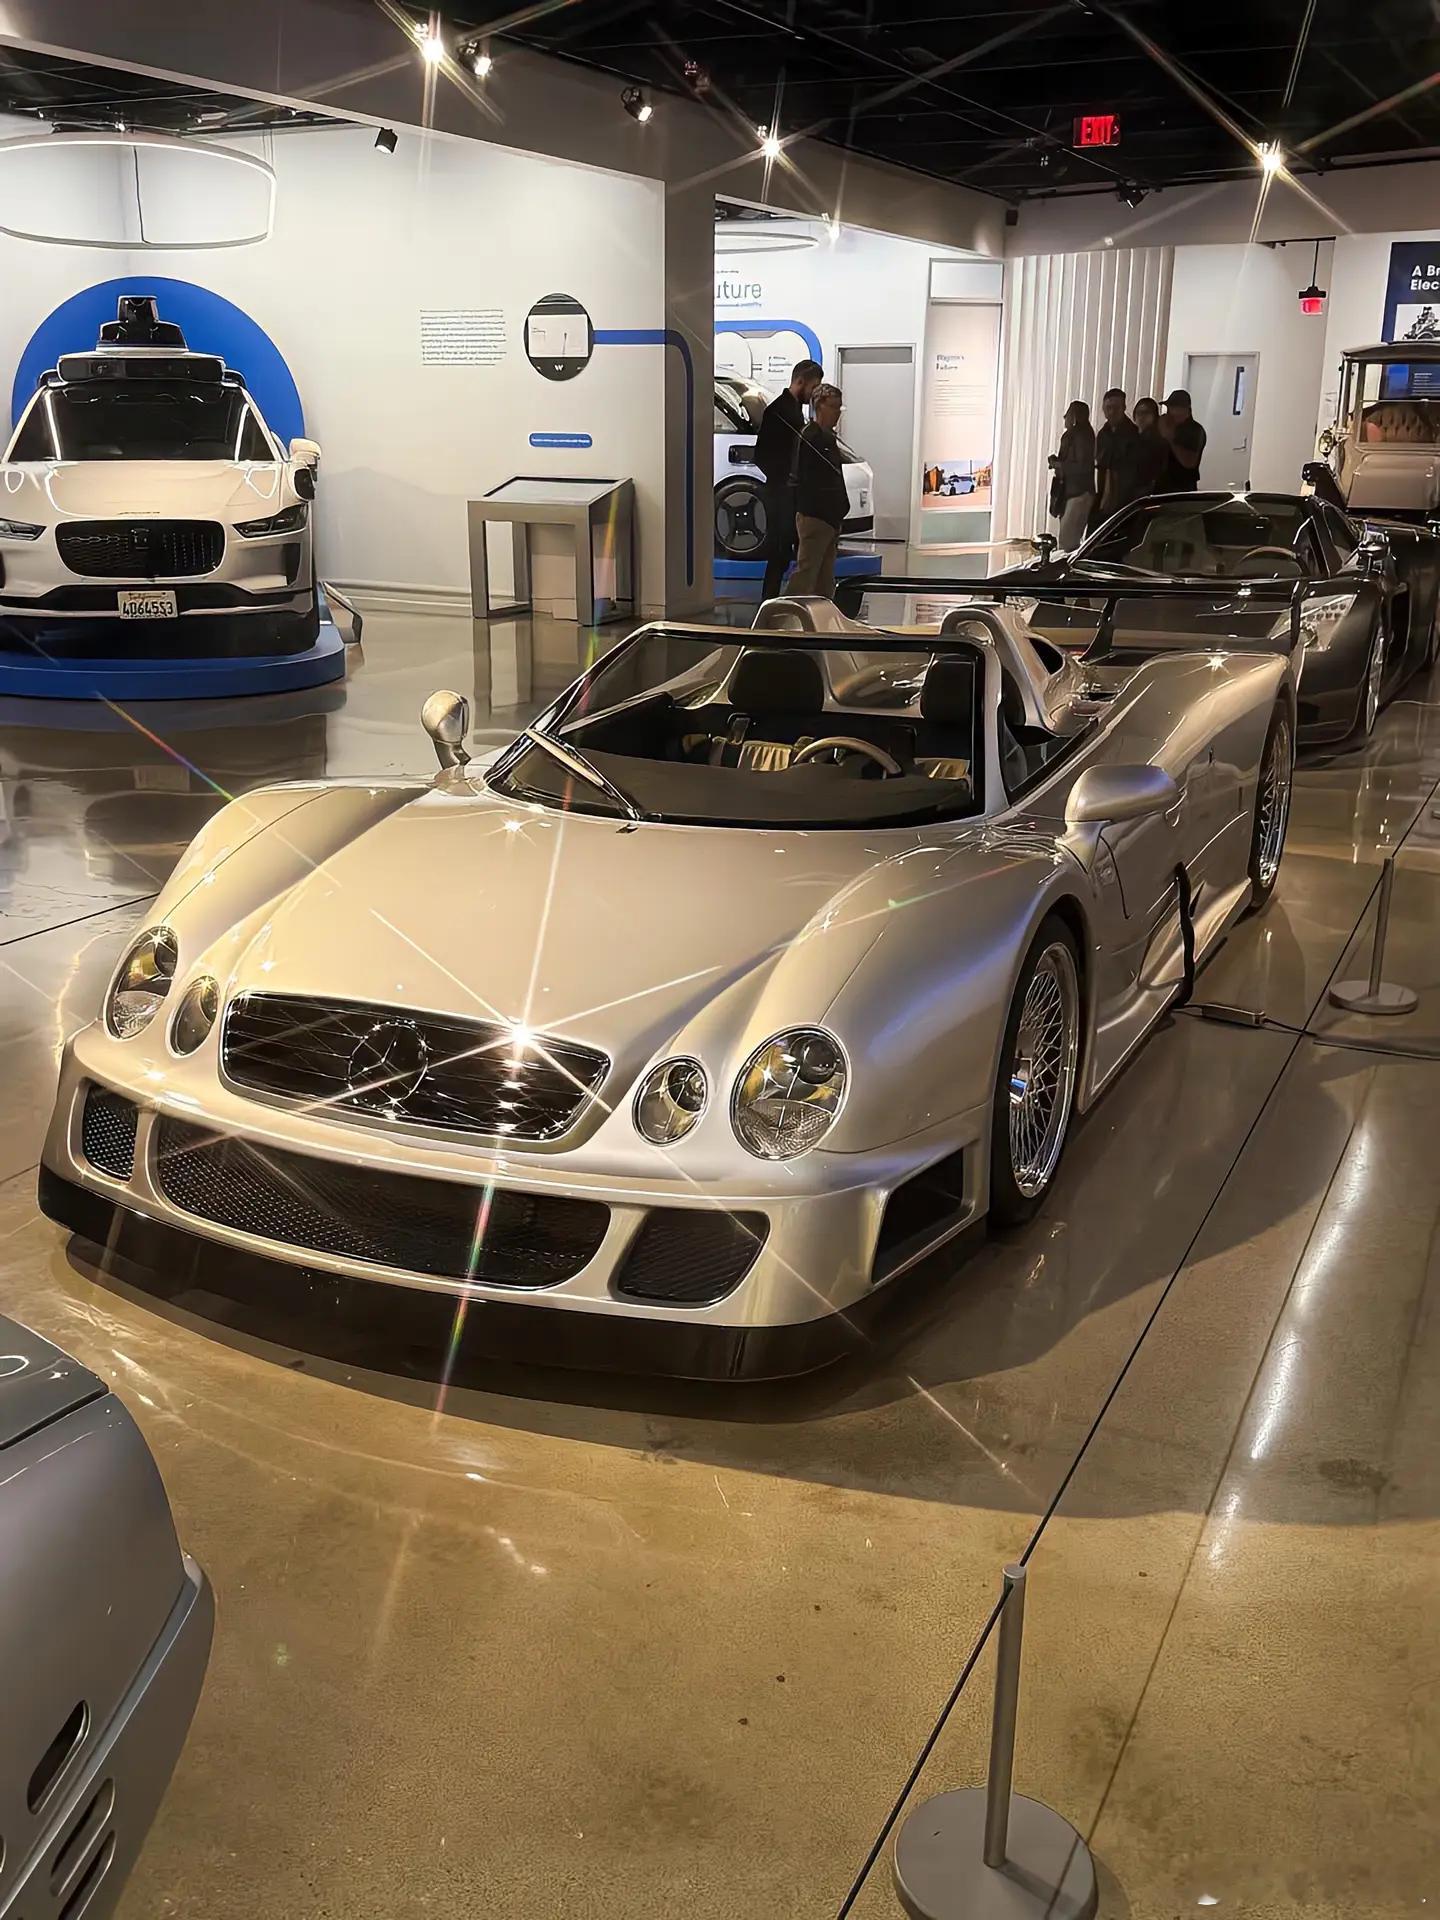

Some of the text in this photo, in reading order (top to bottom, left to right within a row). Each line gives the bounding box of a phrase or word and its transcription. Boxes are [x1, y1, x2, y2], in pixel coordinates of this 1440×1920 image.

[1081, 116, 1114, 144] EXIT
[1411, 265, 1422, 277] A
[1410, 278, 1440, 291] Elec
